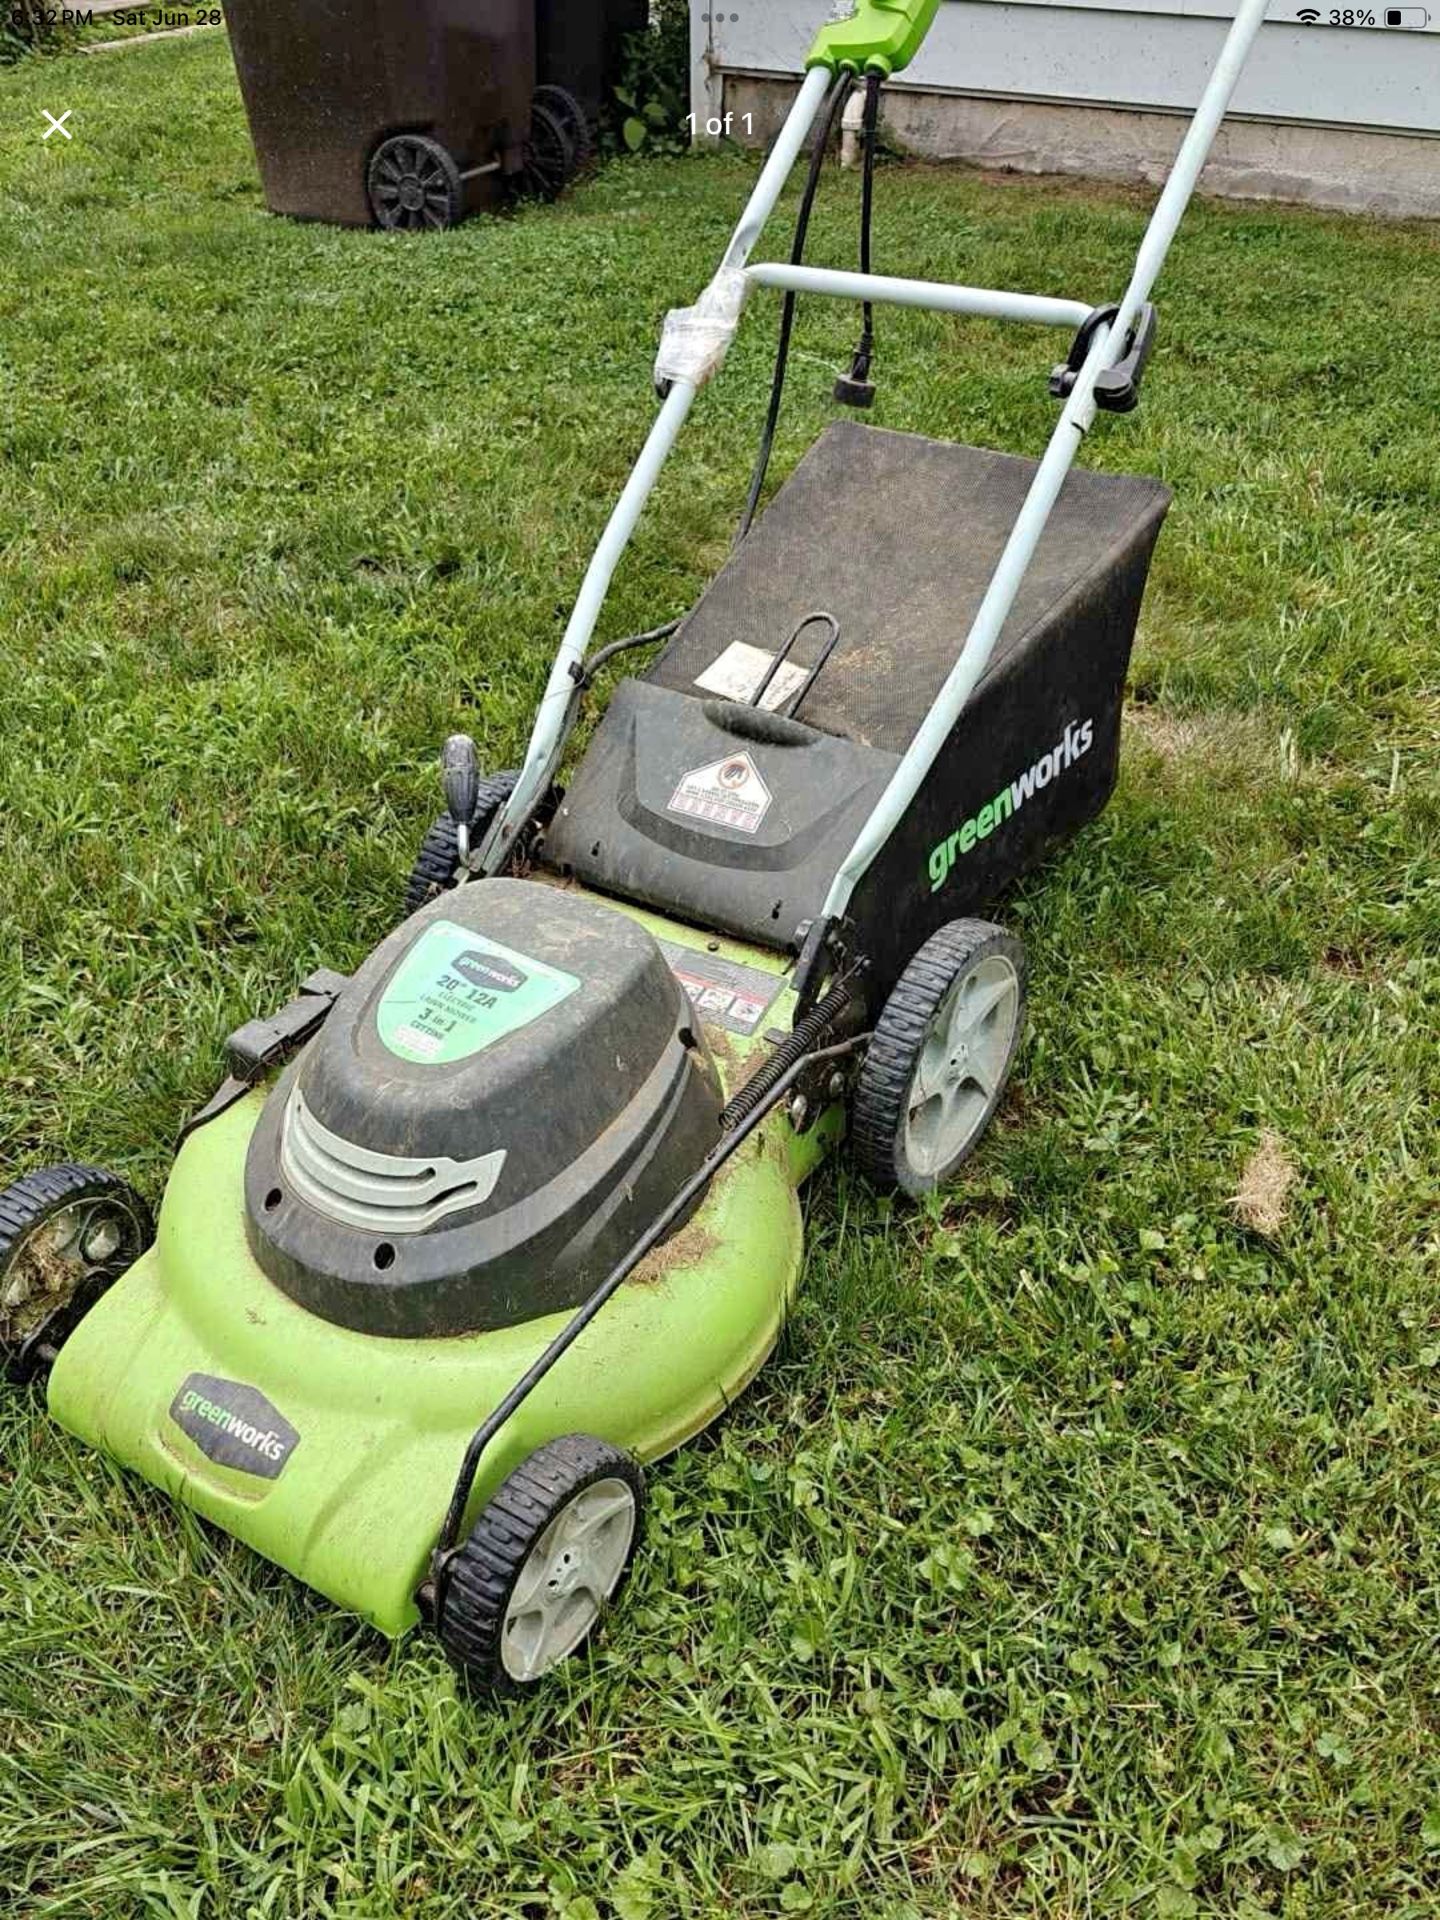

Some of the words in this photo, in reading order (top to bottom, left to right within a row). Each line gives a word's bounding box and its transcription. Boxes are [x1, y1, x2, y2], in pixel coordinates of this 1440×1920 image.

[927, 717, 1094, 893] greenworks
[459, 957, 520, 987] greenworks
[466, 987, 499, 1010] 12A
[418, 1006, 433, 1022] 3
[445, 1019, 458, 1033] 1
[180, 1390, 285, 1460] greenworks
